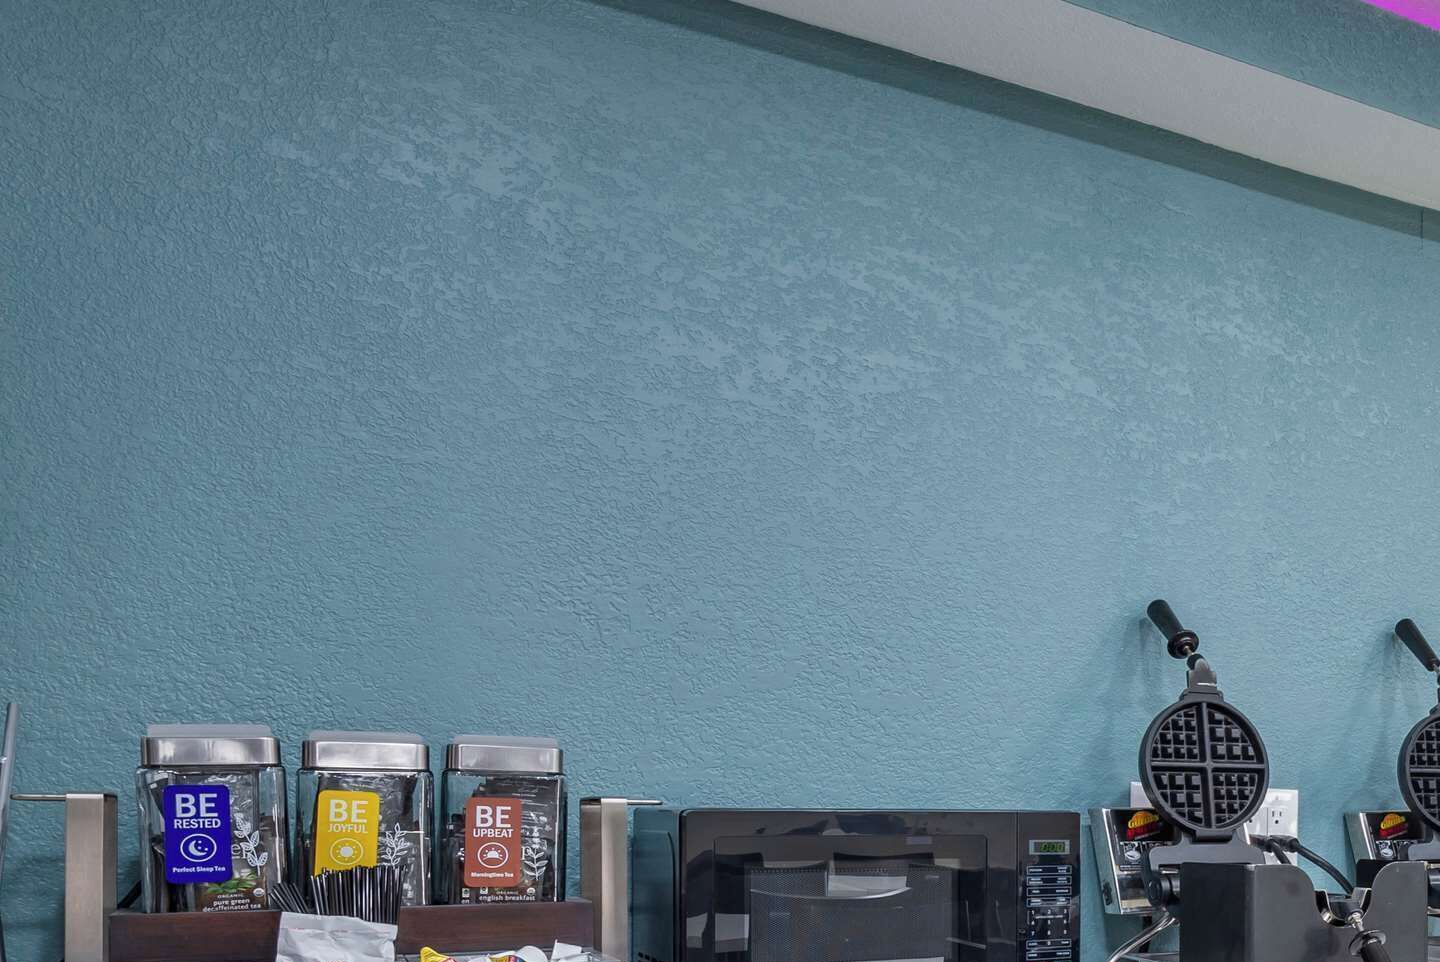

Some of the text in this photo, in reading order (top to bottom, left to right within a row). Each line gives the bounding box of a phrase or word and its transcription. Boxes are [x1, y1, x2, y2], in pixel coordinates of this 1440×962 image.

[175, 793, 218, 818] BE
[328, 800, 368, 823] BE
[476, 806, 512, 828] BE
[174, 818, 221, 829] RESTED
[328, 823, 368, 834] JOYFUL
[473, 828, 514, 838] UPBEAT
[203, 904, 248, 912] decaffeinated
